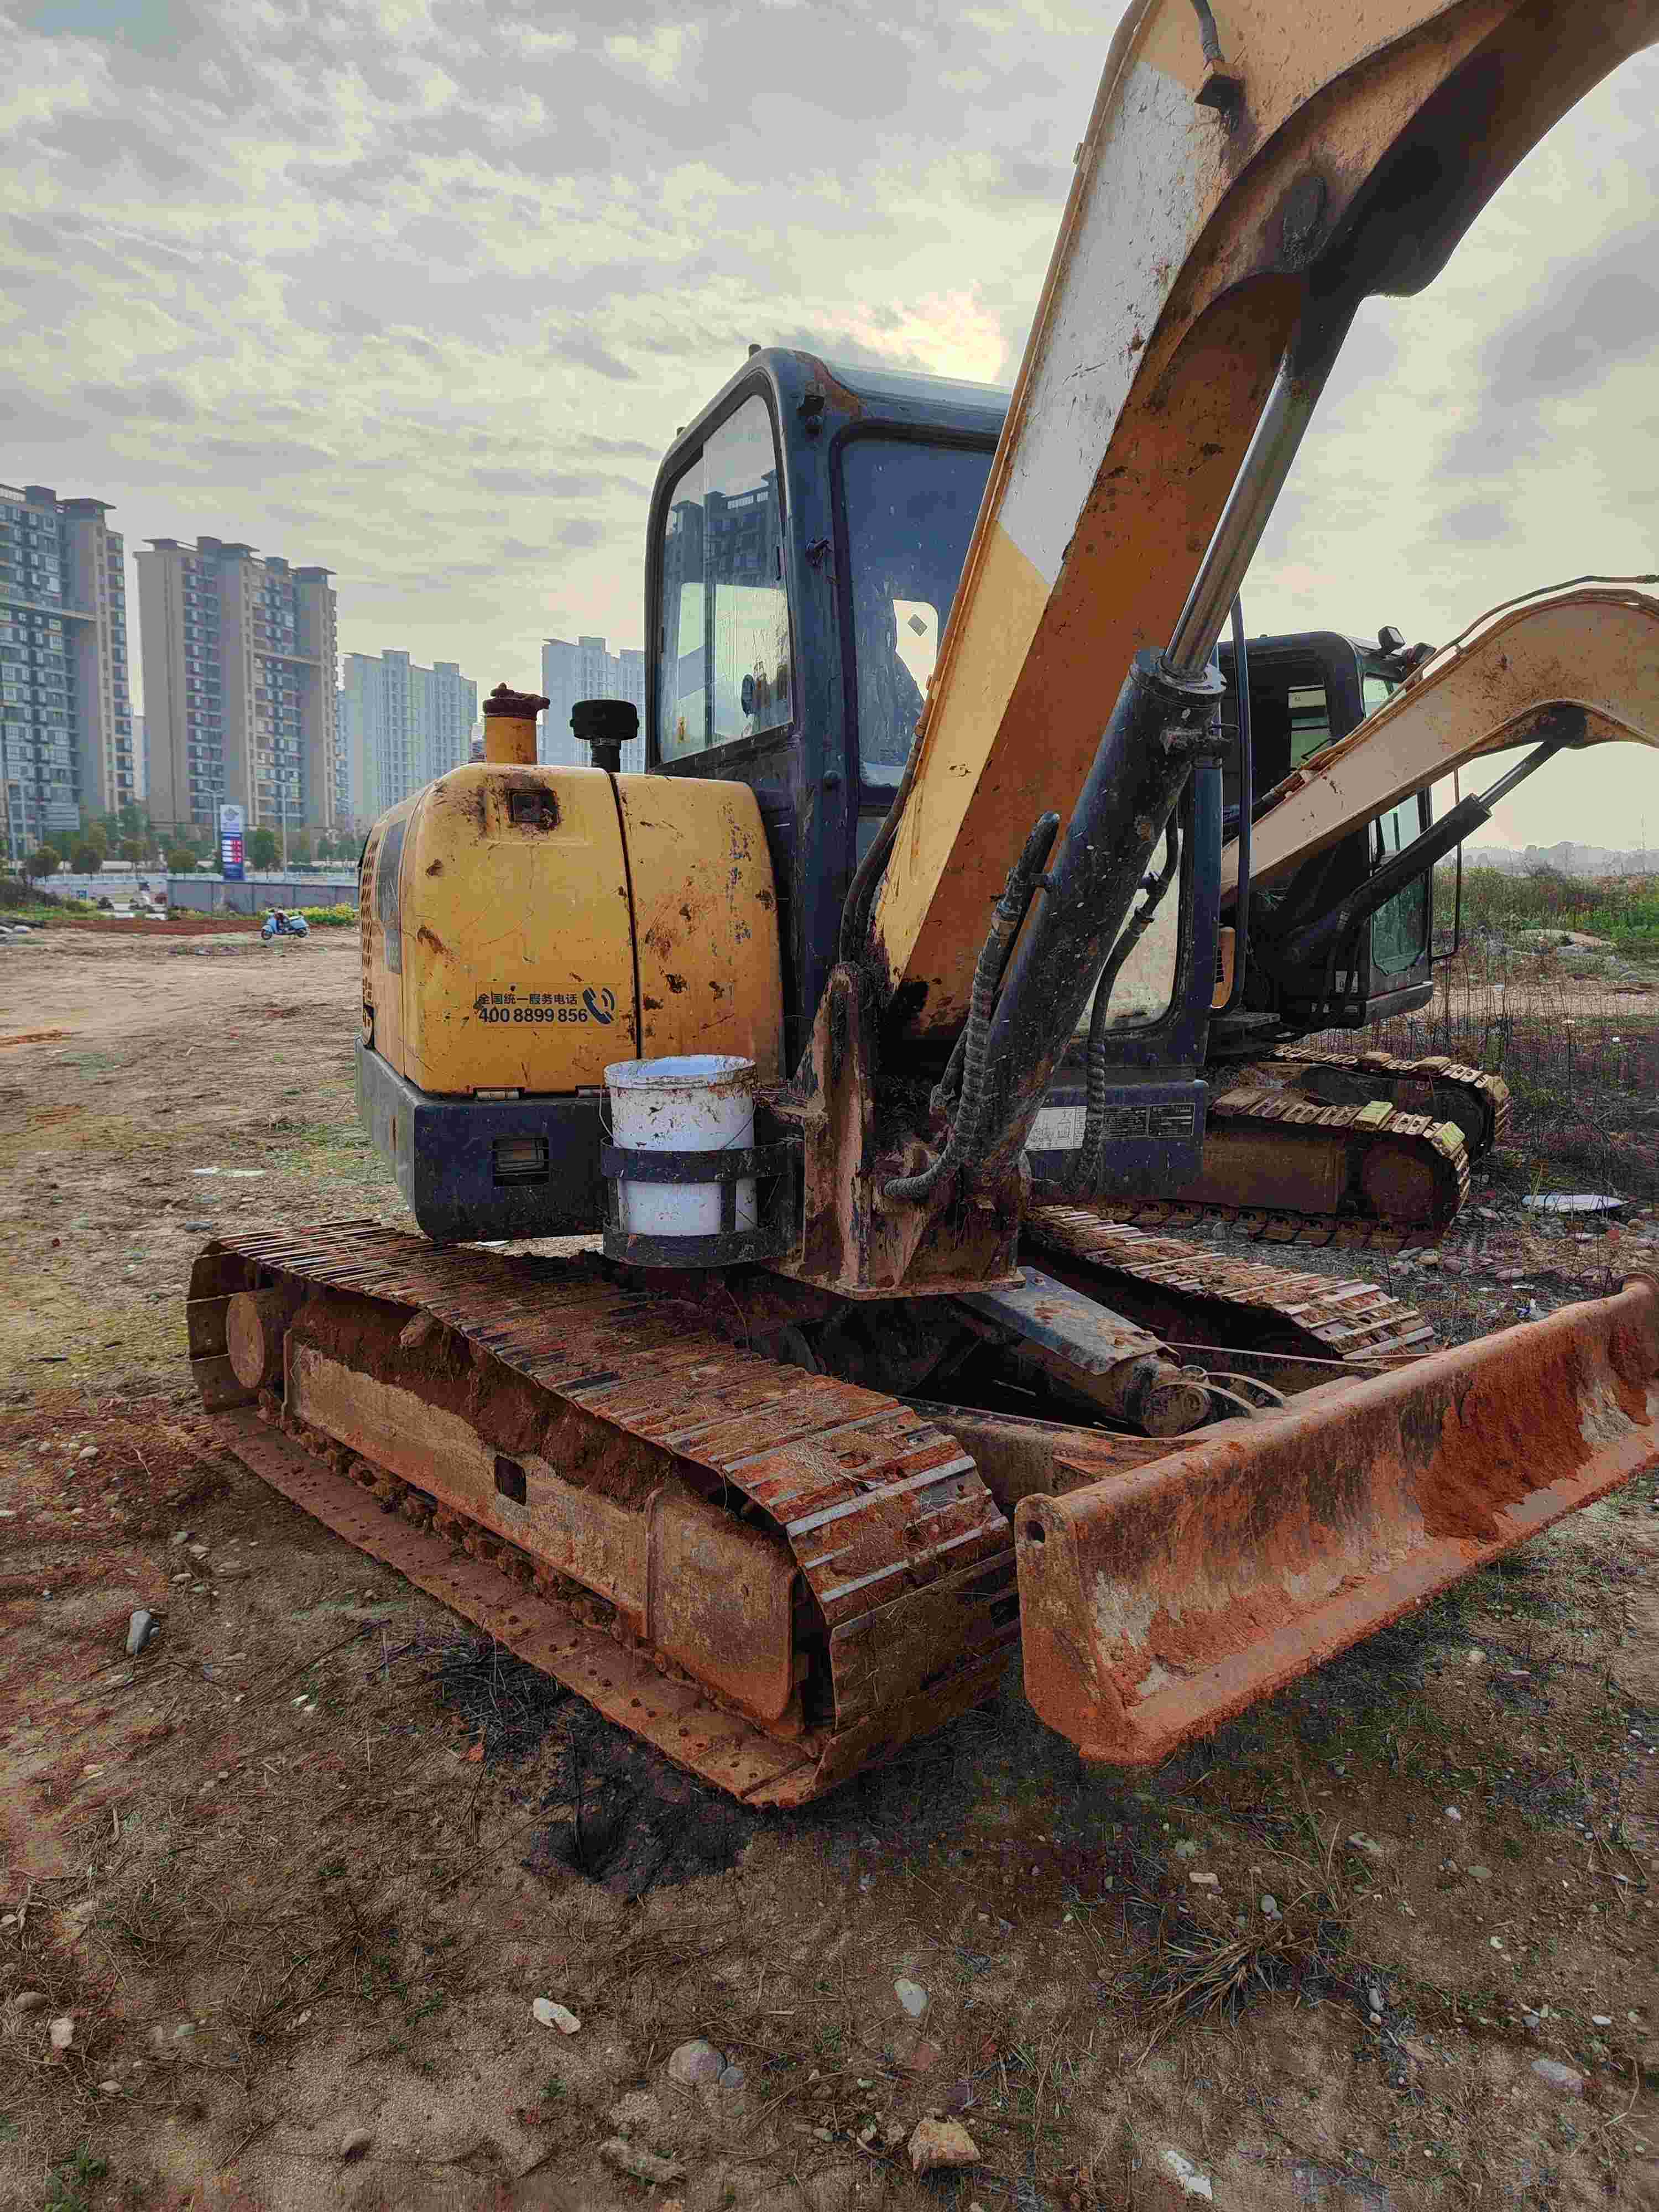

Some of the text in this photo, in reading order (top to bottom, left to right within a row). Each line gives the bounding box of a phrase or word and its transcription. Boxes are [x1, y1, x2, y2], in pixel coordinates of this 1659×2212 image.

[478, 993, 577, 1005] 全国统一服务电话
[478, 1008, 588, 1022] 400 8899 856
